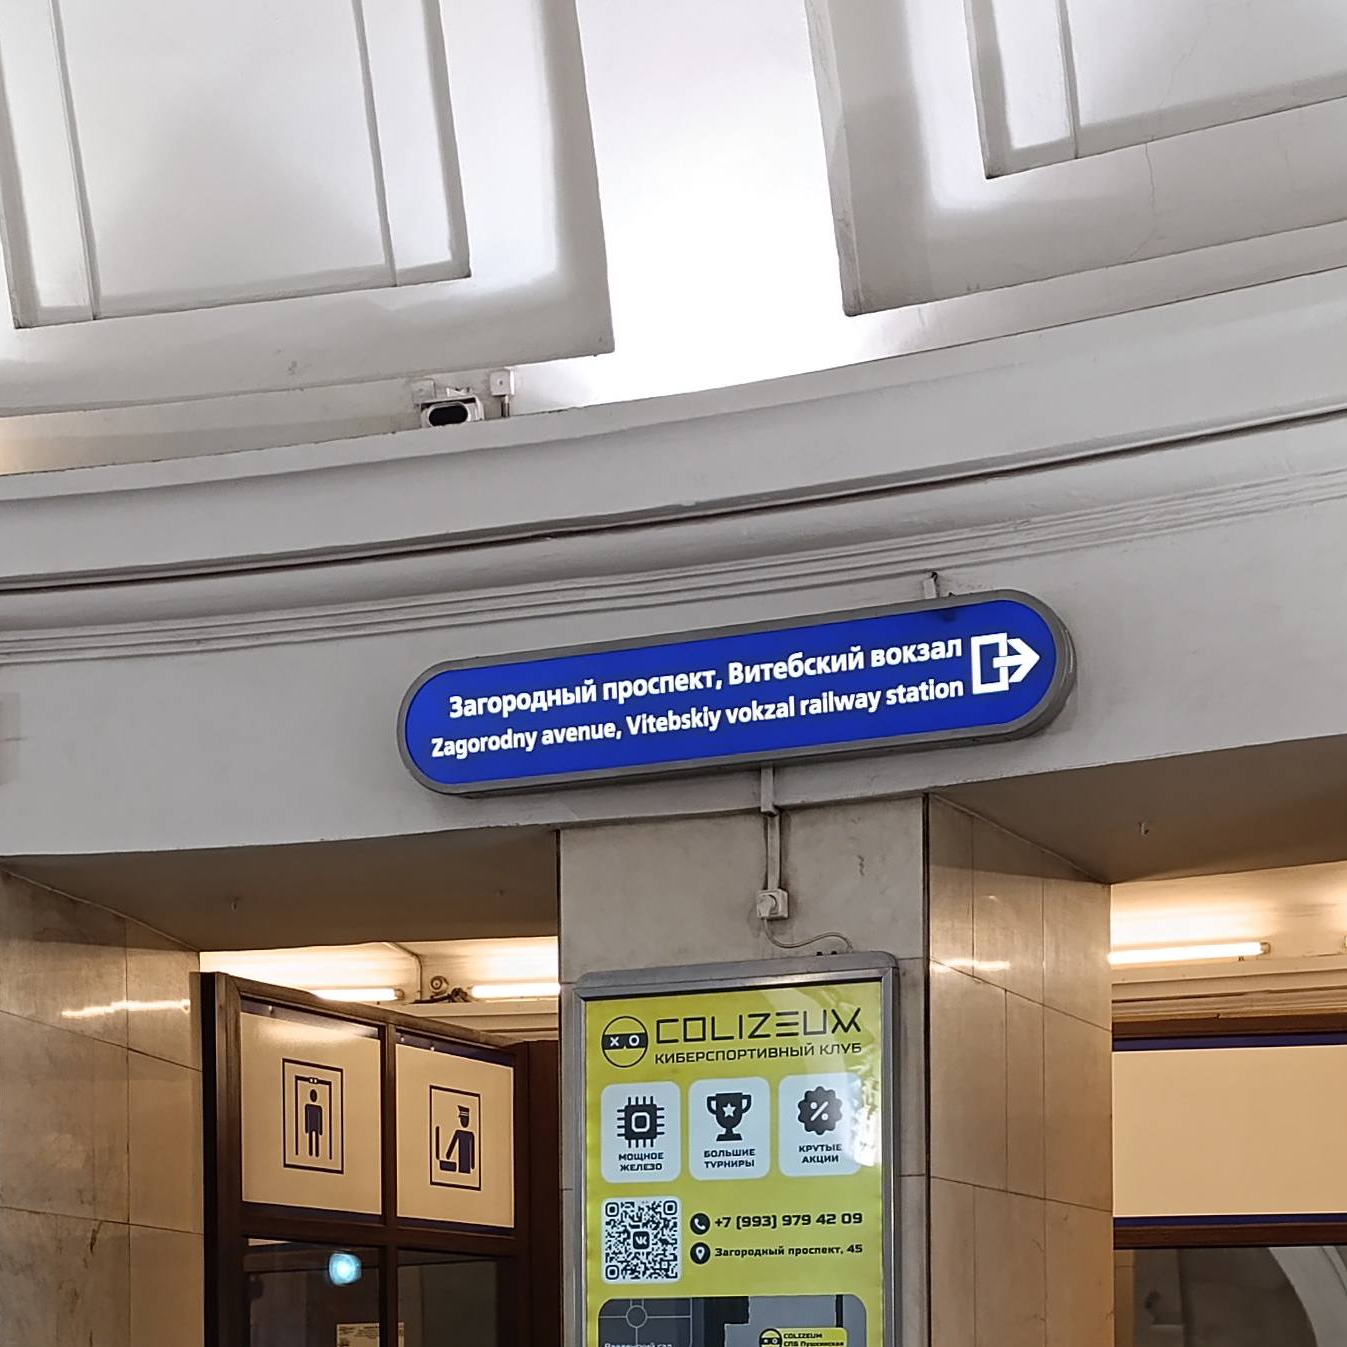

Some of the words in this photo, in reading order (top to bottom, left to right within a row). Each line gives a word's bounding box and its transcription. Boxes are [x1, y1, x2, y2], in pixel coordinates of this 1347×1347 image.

[448, 678, 597, 722] Загородный
[602, 665, 723, 704] проспект,
[728, 645, 866, 688] Витебский
[871, 637, 963, 669] вокзал
[431, 727, 538, 761] Zagorodny
[541, 720, 623, 746] avenue,
[626, 706, 722, 738] Vitebskiy
[725, 696, 796, 723] vokzal
[800, 687, 882, 718] railway
[885, 677, 965, 702] station
[656, 1007, 862, 1044] COLIZEUM
[655, 1046, 815, 1065] КИБЕРСПОРТИВНЫЙ
[819, 1042, 862, 1056] КЛУБ
[704, 1148, 756, 1158] БОЛЬШИЕ
[799, 1144, 842, 1153] КРУТЫЕ
[618, 1152, 664, 1162] МОЩНОЕ
[802, 1155, 839, 1164] АКЦИИ
[620, 1163, 662, 1172] ЖЕЛЕЗО
[705, 1159, 755, 1169] ТУРНИРЫ
[715, 1216, 731, 1229] +7
[782, 1214, 811, 1227] 979
[816, 1213, 836, 1225] 42
[842, 1213, 863, 1225] 09
[715, 1246, 785, 1258] Загородный
[847, 1244, 863, 1254] 45
